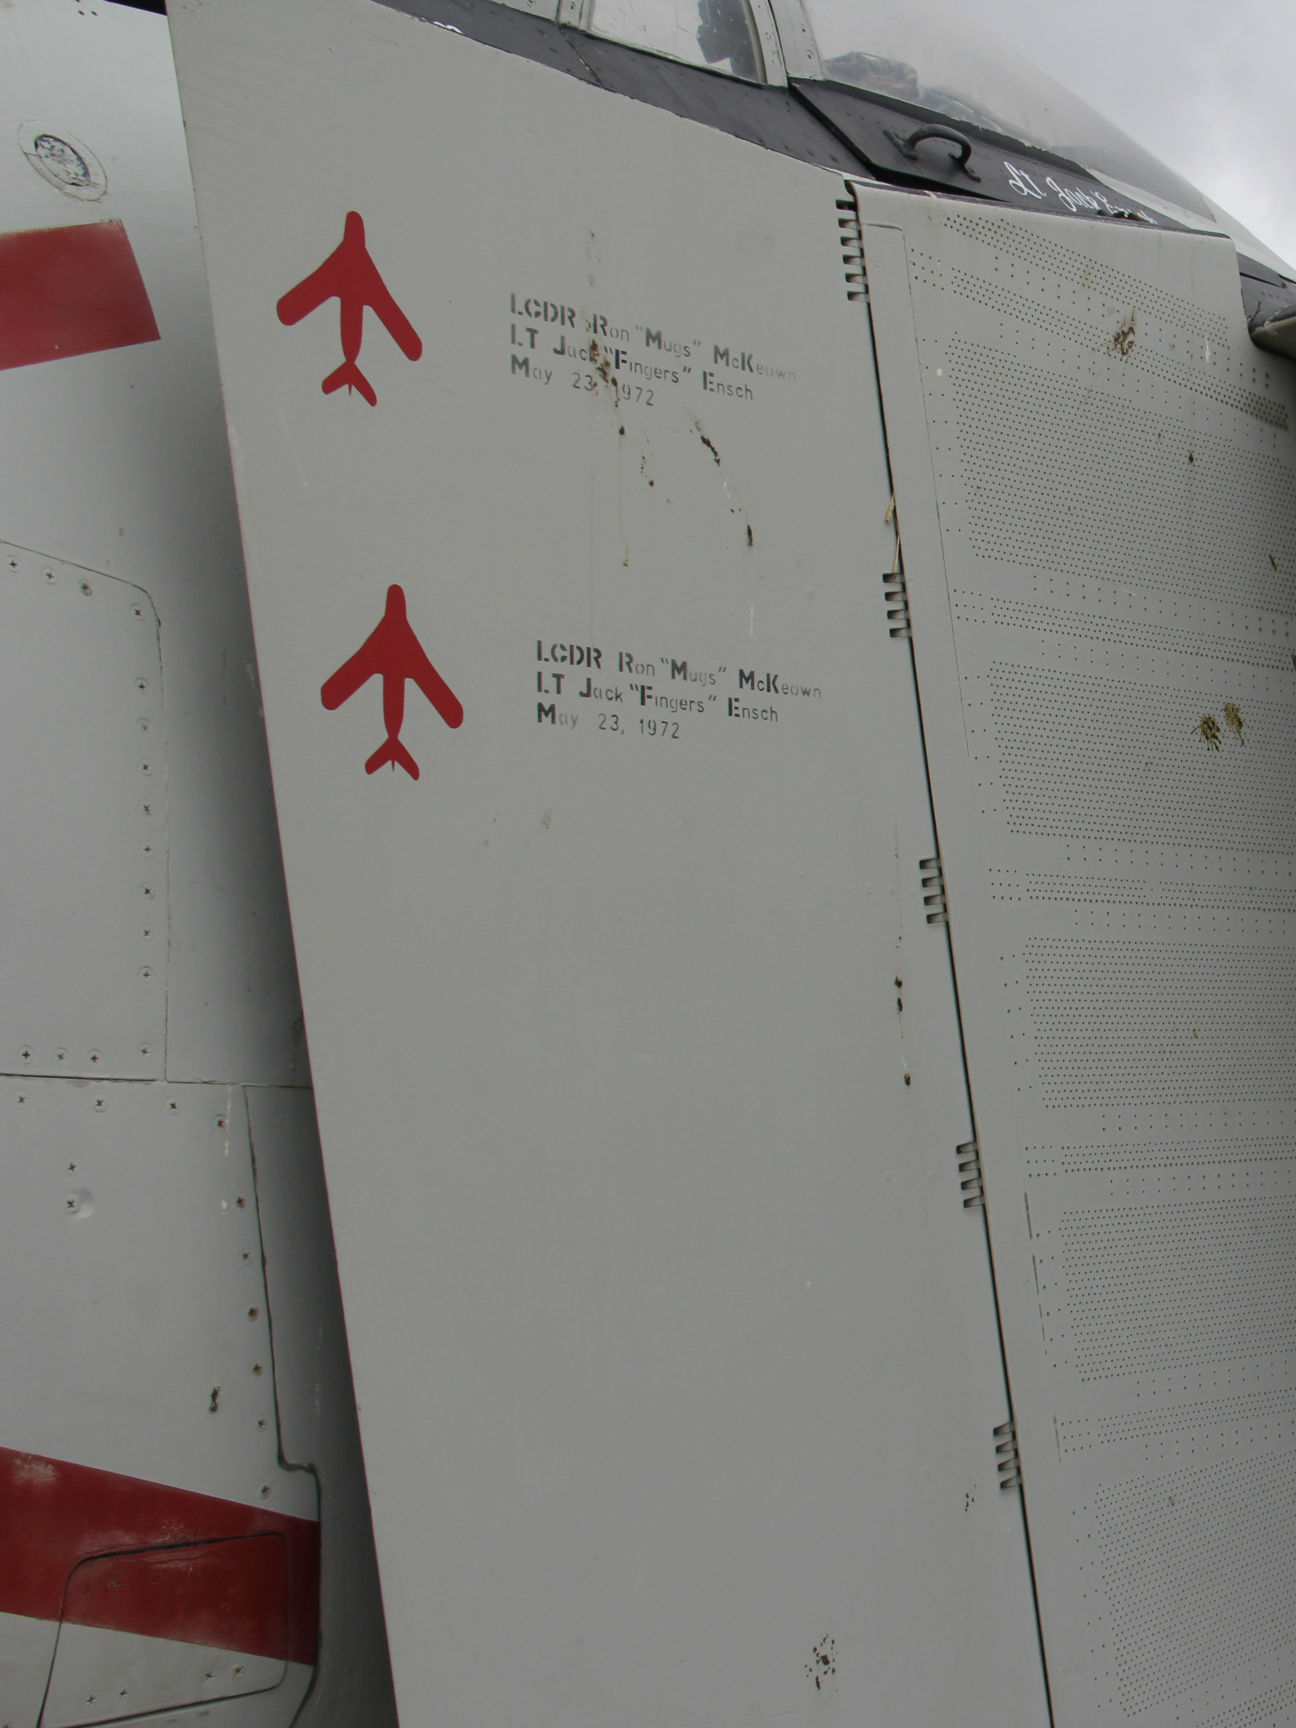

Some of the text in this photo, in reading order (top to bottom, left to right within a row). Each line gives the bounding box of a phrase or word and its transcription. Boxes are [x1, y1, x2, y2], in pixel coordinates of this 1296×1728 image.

[510, 293, 798, 382] LCDR Ron "Mugs" McKeown
[510, 324, 539, 349] LT
[603, 346, 692, 383] "Fingers"
[702, 370, 754, 401] Ensch
[510, 354, 553, 385] May
[537, 640, 822, 699] LCDR Ron "Mugs" McKeown
[537, 671, 779, 723] LT Jack "Fingers" Ensch
[537, 702, 680, 740] May 23, 1972
